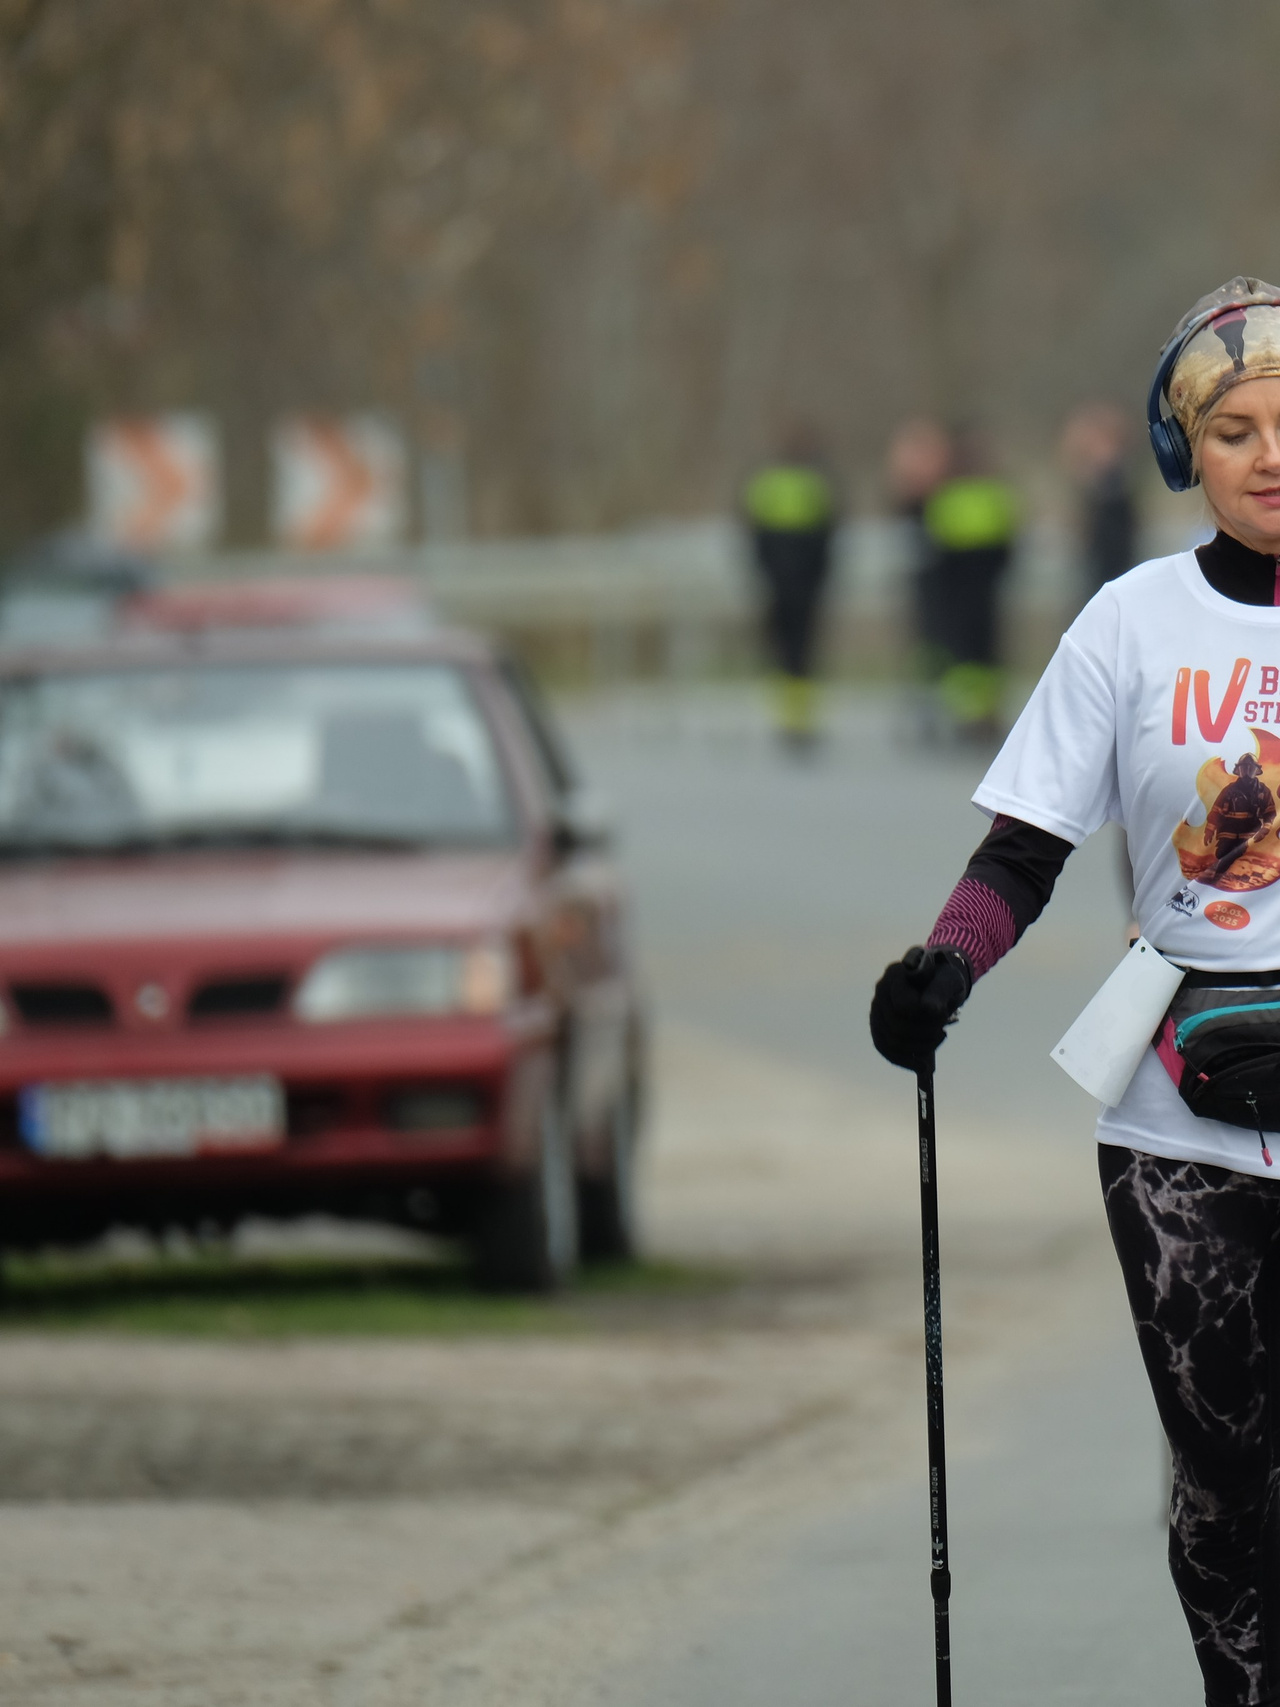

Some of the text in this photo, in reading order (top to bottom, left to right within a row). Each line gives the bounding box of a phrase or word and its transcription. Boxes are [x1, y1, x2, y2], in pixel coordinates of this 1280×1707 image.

[1171, 657, 1251, 746] IV
[1214, 904, 1243, 919] 30.03.
[1212, 913, 1239, 927] 2025
